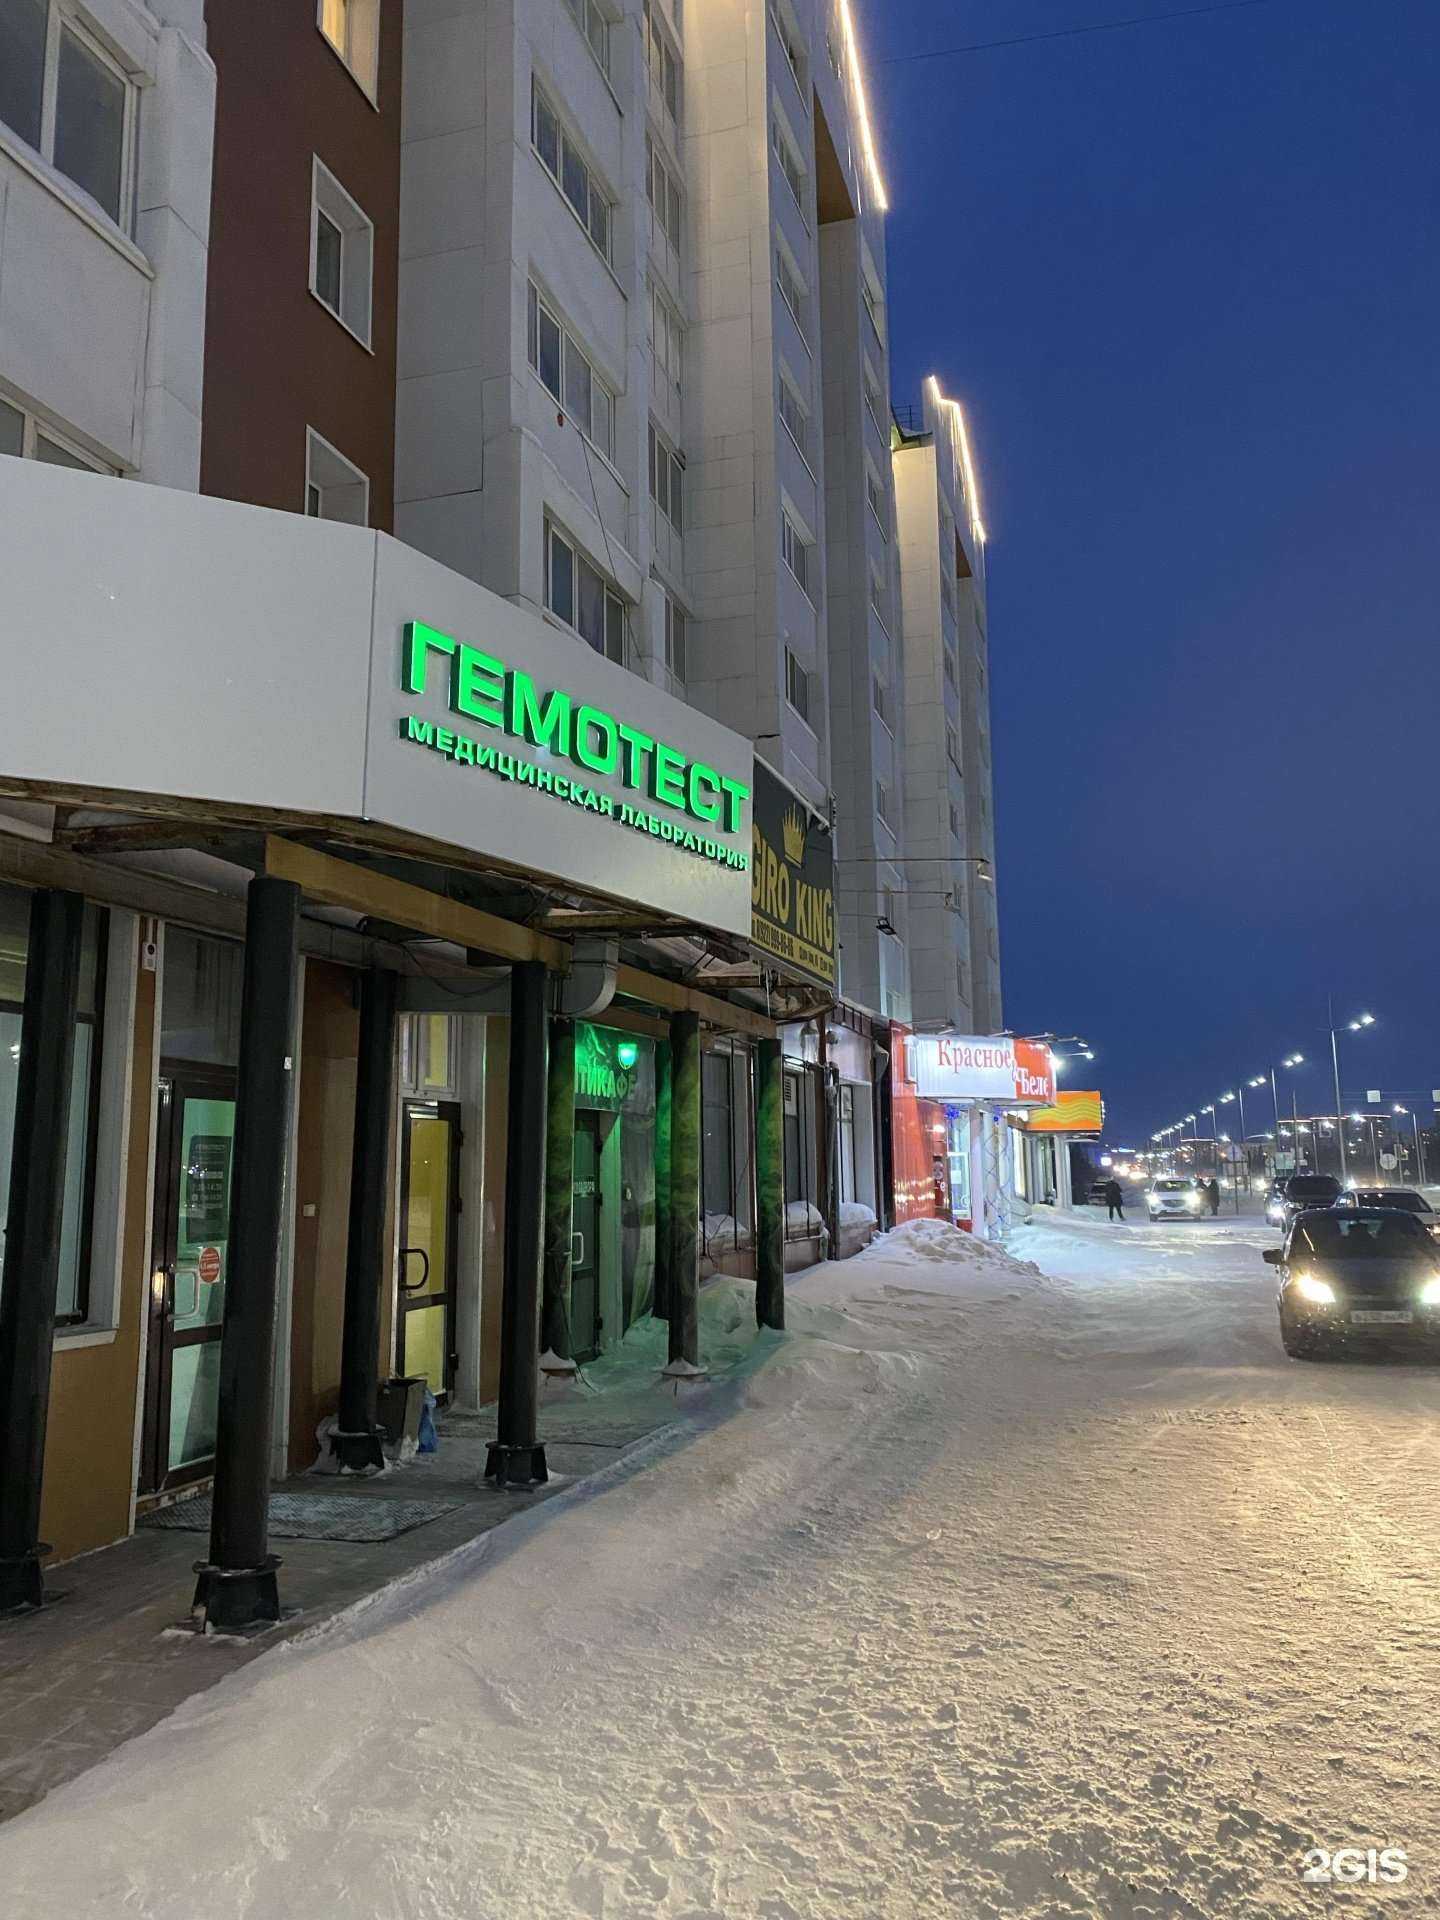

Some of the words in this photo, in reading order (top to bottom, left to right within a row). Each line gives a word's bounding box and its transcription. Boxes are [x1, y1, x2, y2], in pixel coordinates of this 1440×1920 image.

[404, 620, 751, 833] ГЕМОТЕСТ
[406, 715, 613, 817] МЕДИЦИНСКАЯ
[620, 803, 750, 872] ЛАБОРАТОРИЯ
[752, 823, 789, 924] GIRO
[796, 879, 833, 953] KING
[937, 1039, 1011, 1073] Красное
